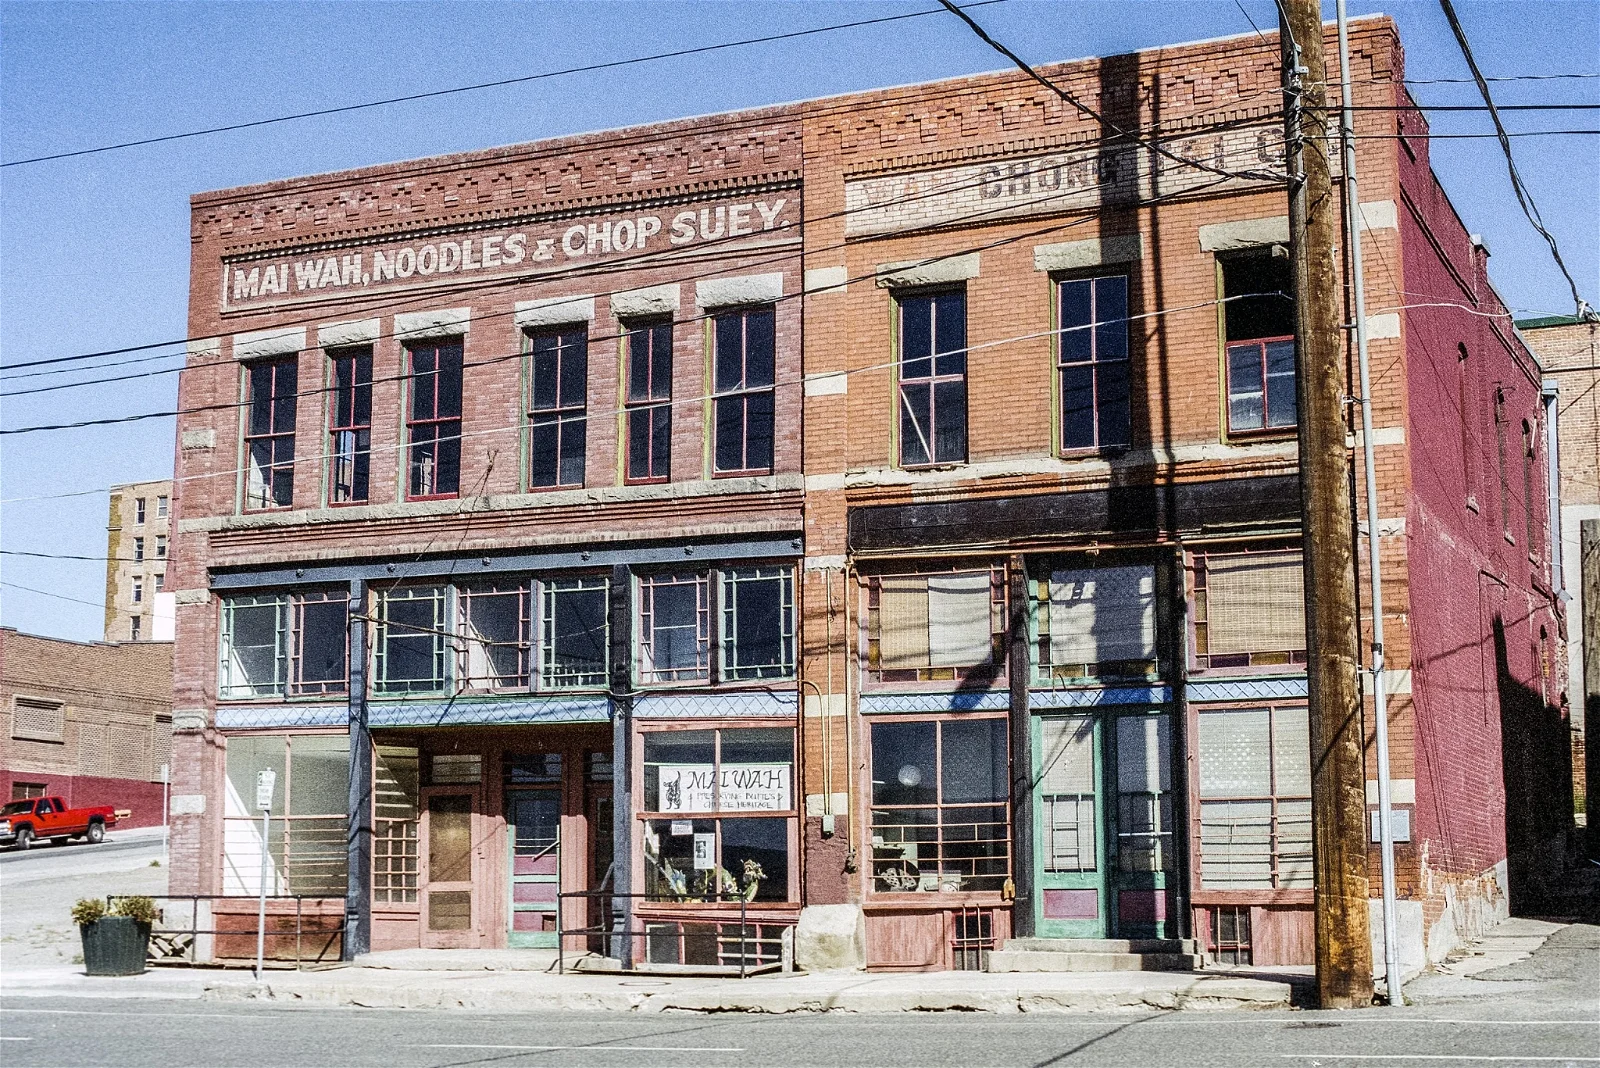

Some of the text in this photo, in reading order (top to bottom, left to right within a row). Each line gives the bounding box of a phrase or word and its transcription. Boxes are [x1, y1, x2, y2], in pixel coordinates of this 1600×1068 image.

[233, 198, 791, 300] MAI WAH, NOODLES & CHOP SUEY.
[686, 768, 784, 790] MAI WAH
[736, 801, 774, 809] HERITAGE
